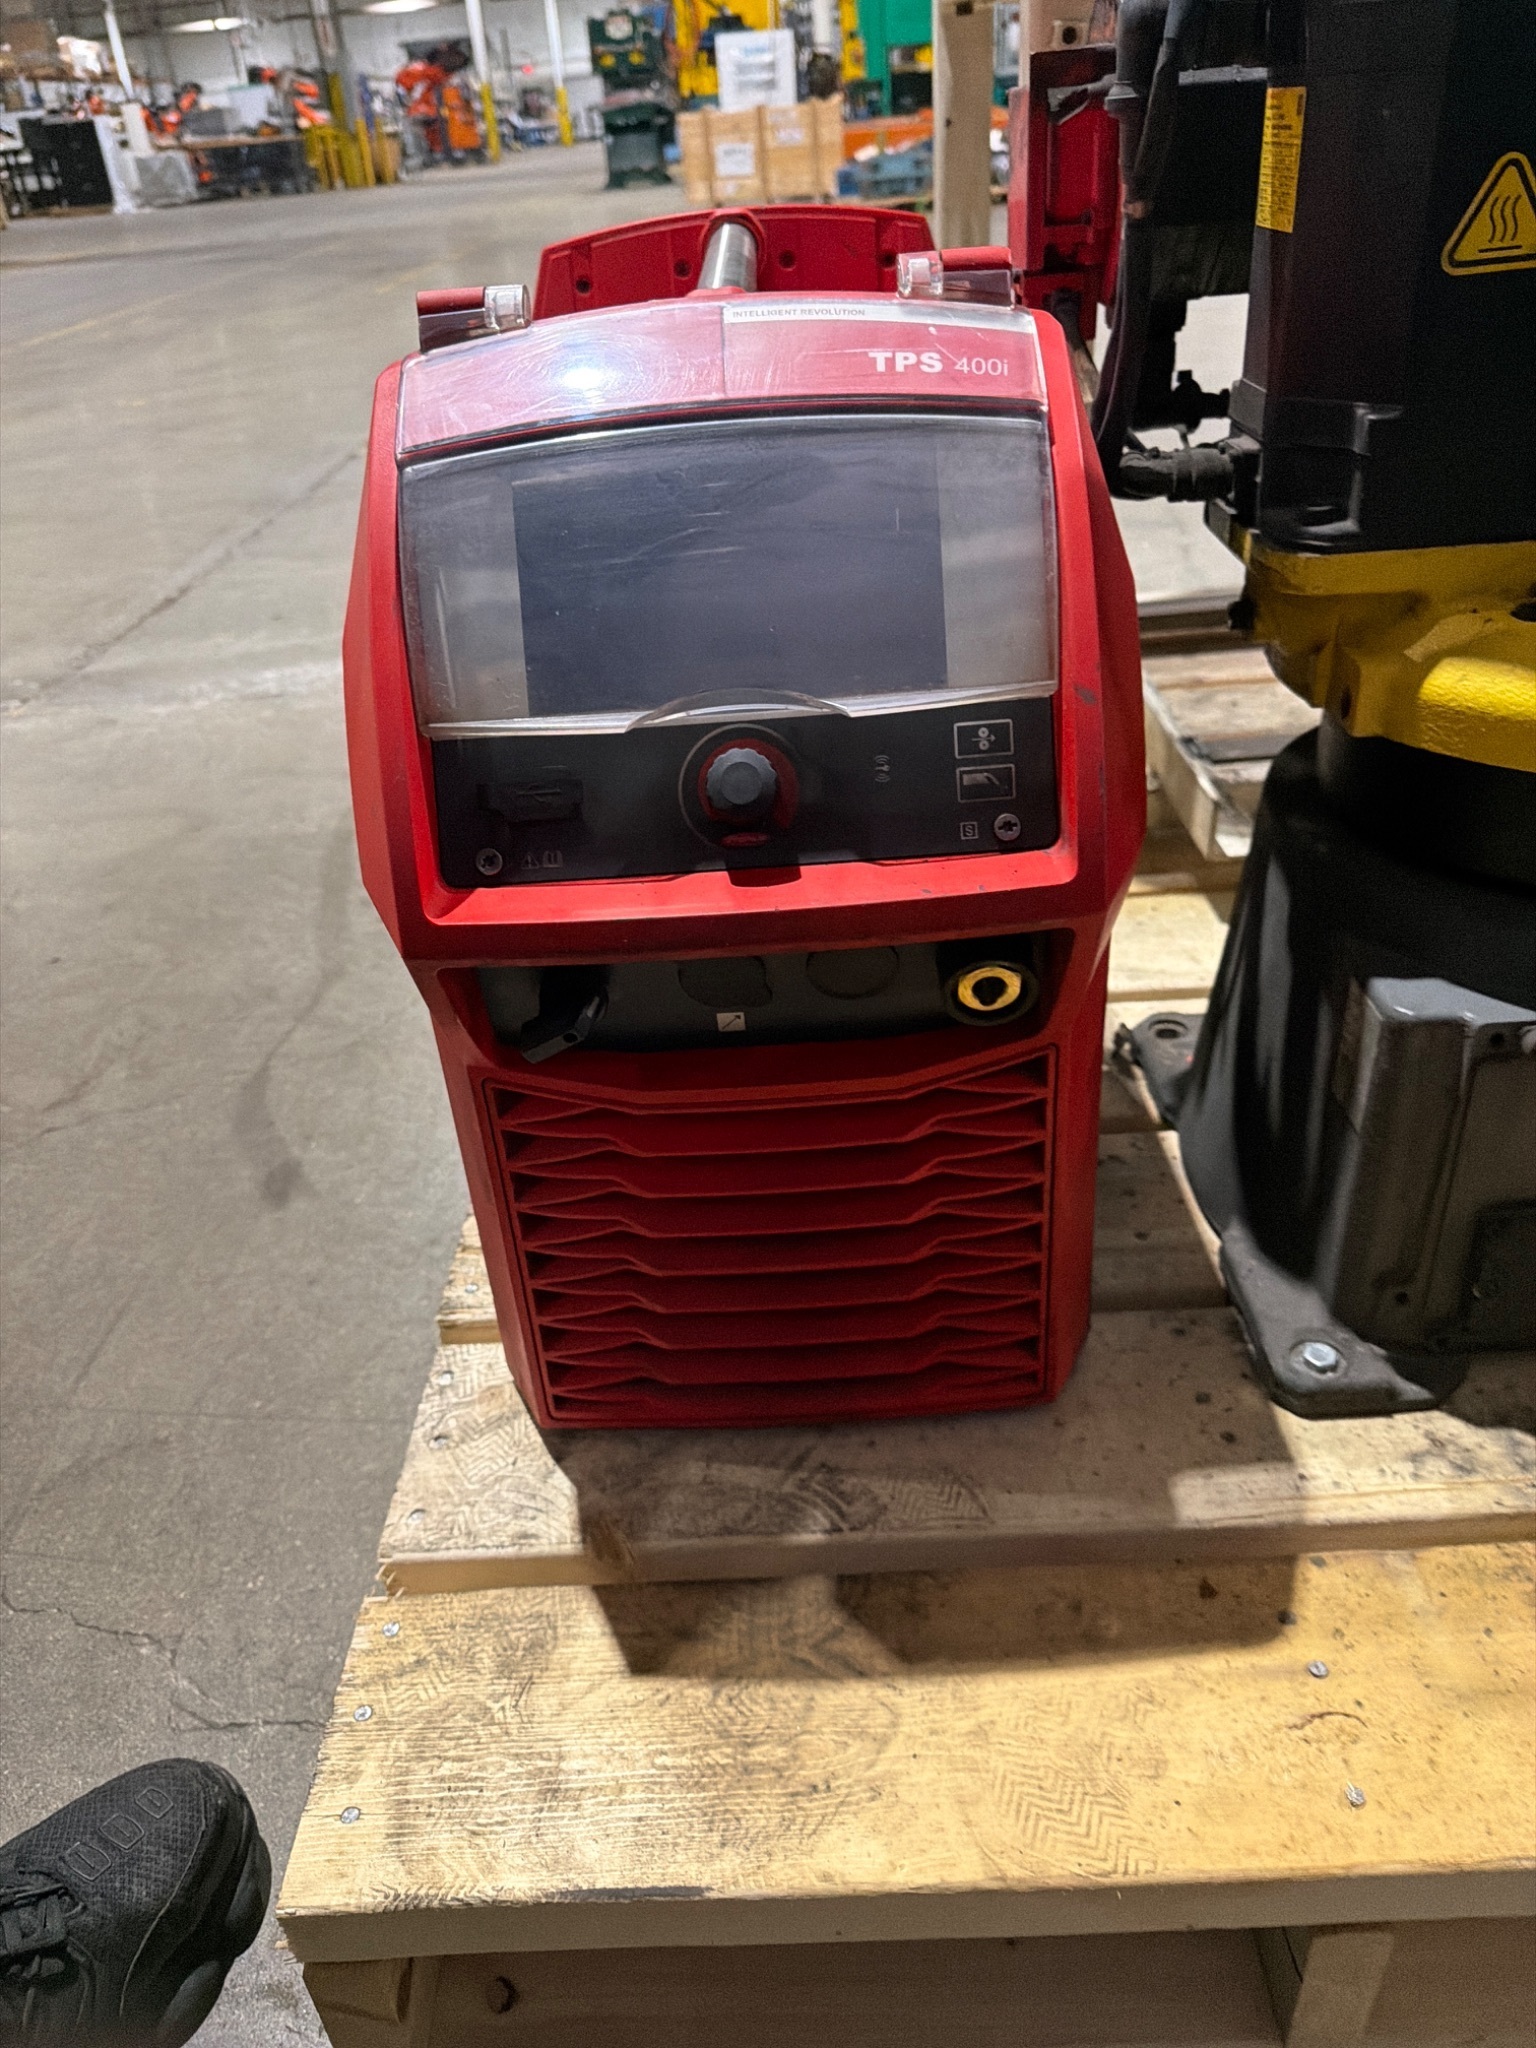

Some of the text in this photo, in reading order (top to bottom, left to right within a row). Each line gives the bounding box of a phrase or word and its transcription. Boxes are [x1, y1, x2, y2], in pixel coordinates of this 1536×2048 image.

[732, 308, 865, 318] INTELLIGENT REVOLUTION
[868, 351, 1008, 376] TPS 400i
